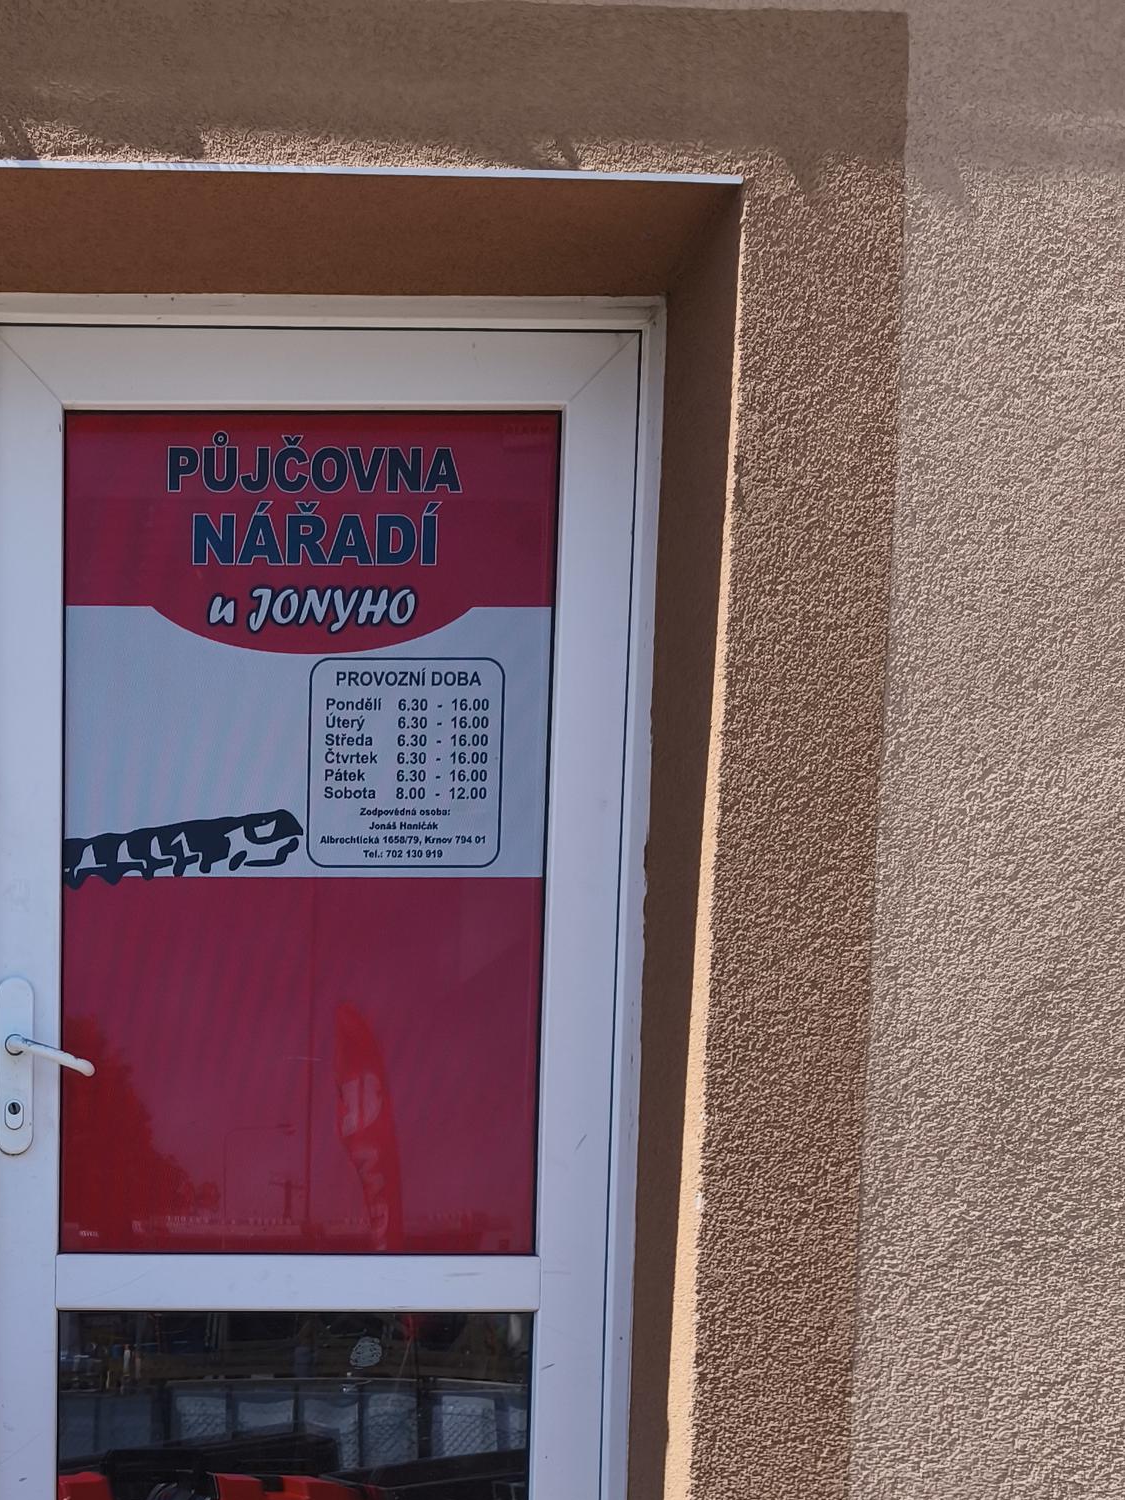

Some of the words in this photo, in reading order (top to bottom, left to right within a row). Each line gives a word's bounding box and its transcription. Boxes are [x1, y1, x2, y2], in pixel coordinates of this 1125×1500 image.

[168, 431, 462, 493] PŮJČOVNA
[192, 501, 442, 566] NÁŘADÍ
[208, 595, 236, 624] u
[248, 587, 416, 632] JONYHO
[336, 668, 426, 687] PROVOZNÍ
[431, 671, 482, 687] DOBA
[325, 698, 382, 711] Pondělí
[398, 699, 428, 711] 6.30
[451, 699, 489, 711] 16.00
[325, 713, 365, 731] Úterý
[397, 716, 428, 729] 6.30
[451, 716, 489, 729] 16.00
[325, 734, 373, 747] Středa
[397, 734, 427, 747] 6.30
[450, 734, 488, 747] 16.00
[324, 748, 378, 764] Čtvrtek
[396, 752, 426, 764] 6.30
[450, 752, 488, 764] 16.00
[324, 768, 365, 782] Pátek
[396, 769, 426, 782] 6.30
[449, 769, 488, 782] 16.00
[324, 787, 376, 799] Sobota
[395, 787, 426, 800] 8.00
[449, 787, 487, 800] 12.00
